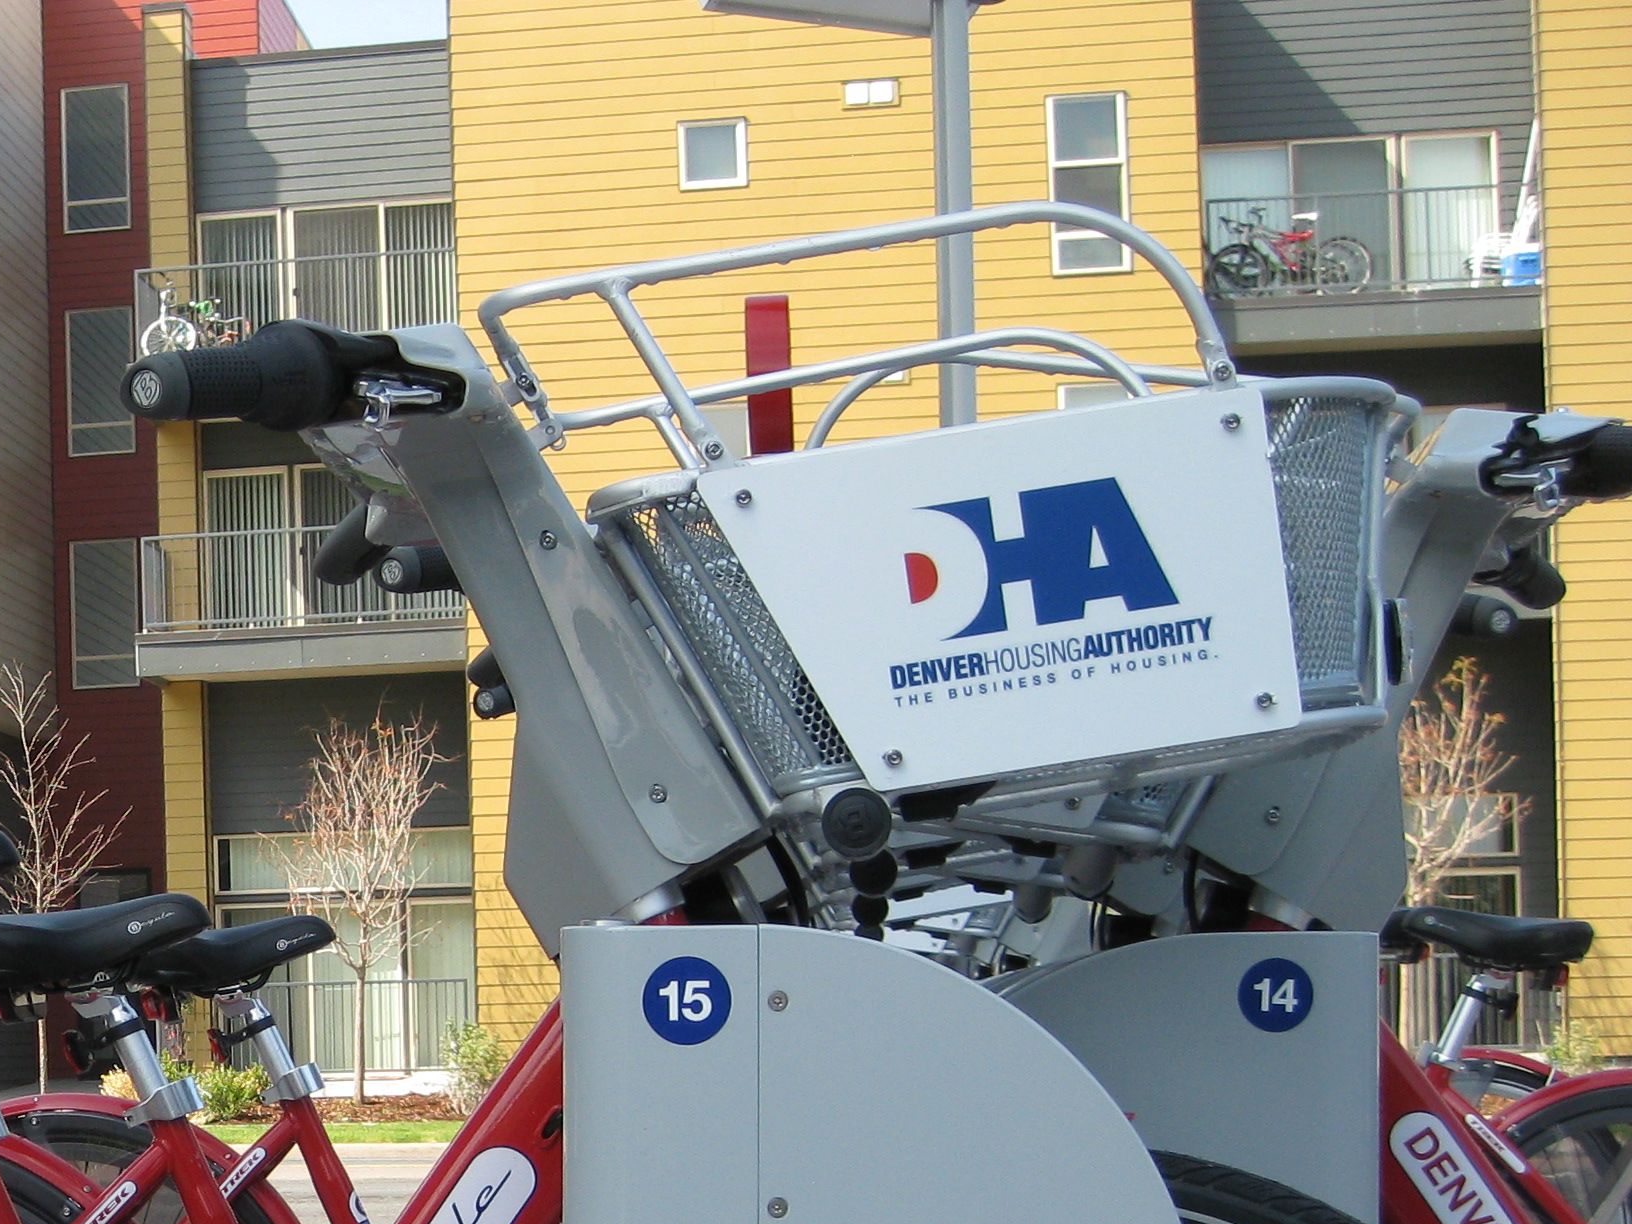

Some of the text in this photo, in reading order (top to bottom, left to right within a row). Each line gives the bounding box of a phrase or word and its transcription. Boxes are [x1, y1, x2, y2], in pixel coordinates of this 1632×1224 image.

[902, 476, 1180, 641] DHA
[894, 692, 934, 707] THE
[947, 671, 1056, 699] BUSINESS
[1071, 665, 1095, 680] OF
[658, 980, 713, 1022] 15
[1252, 977, 1298, 1013] 14
